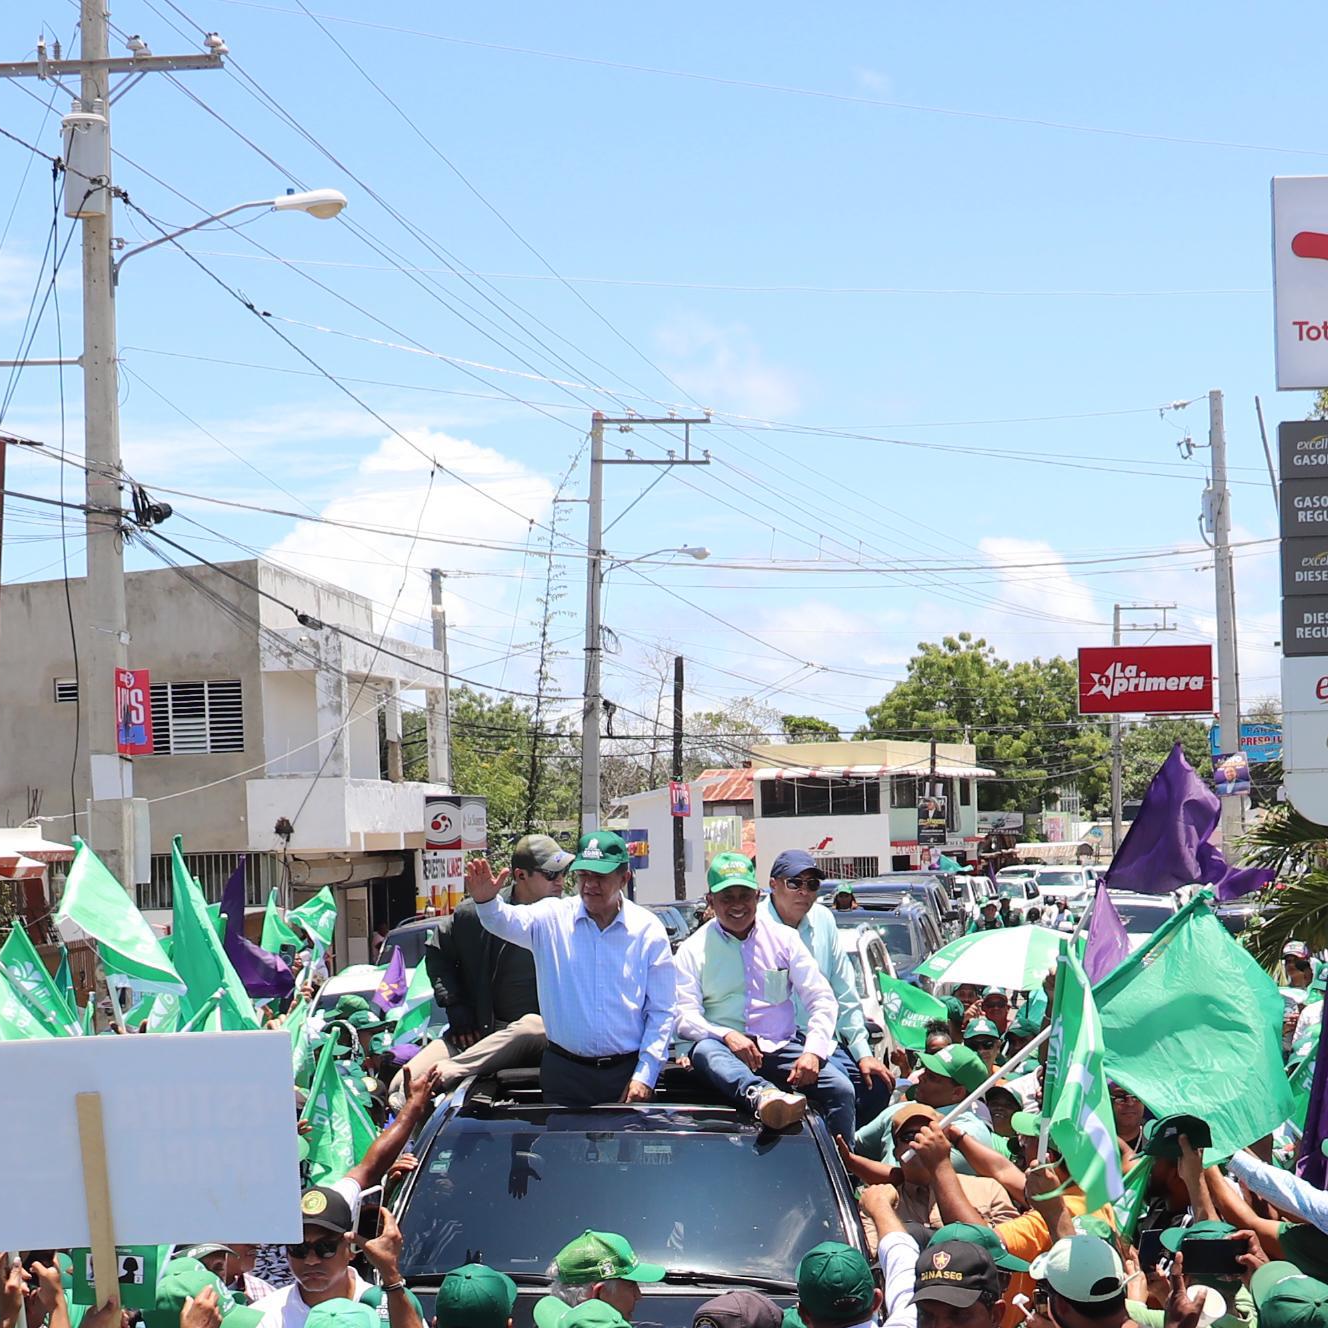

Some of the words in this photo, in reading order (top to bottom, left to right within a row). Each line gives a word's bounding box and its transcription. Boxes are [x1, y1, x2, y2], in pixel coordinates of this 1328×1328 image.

[1116, 661, 1137, 678] La
[1113, 674, 1204, 697] primera
[921, 1271, 963, 1281] DINASEG
